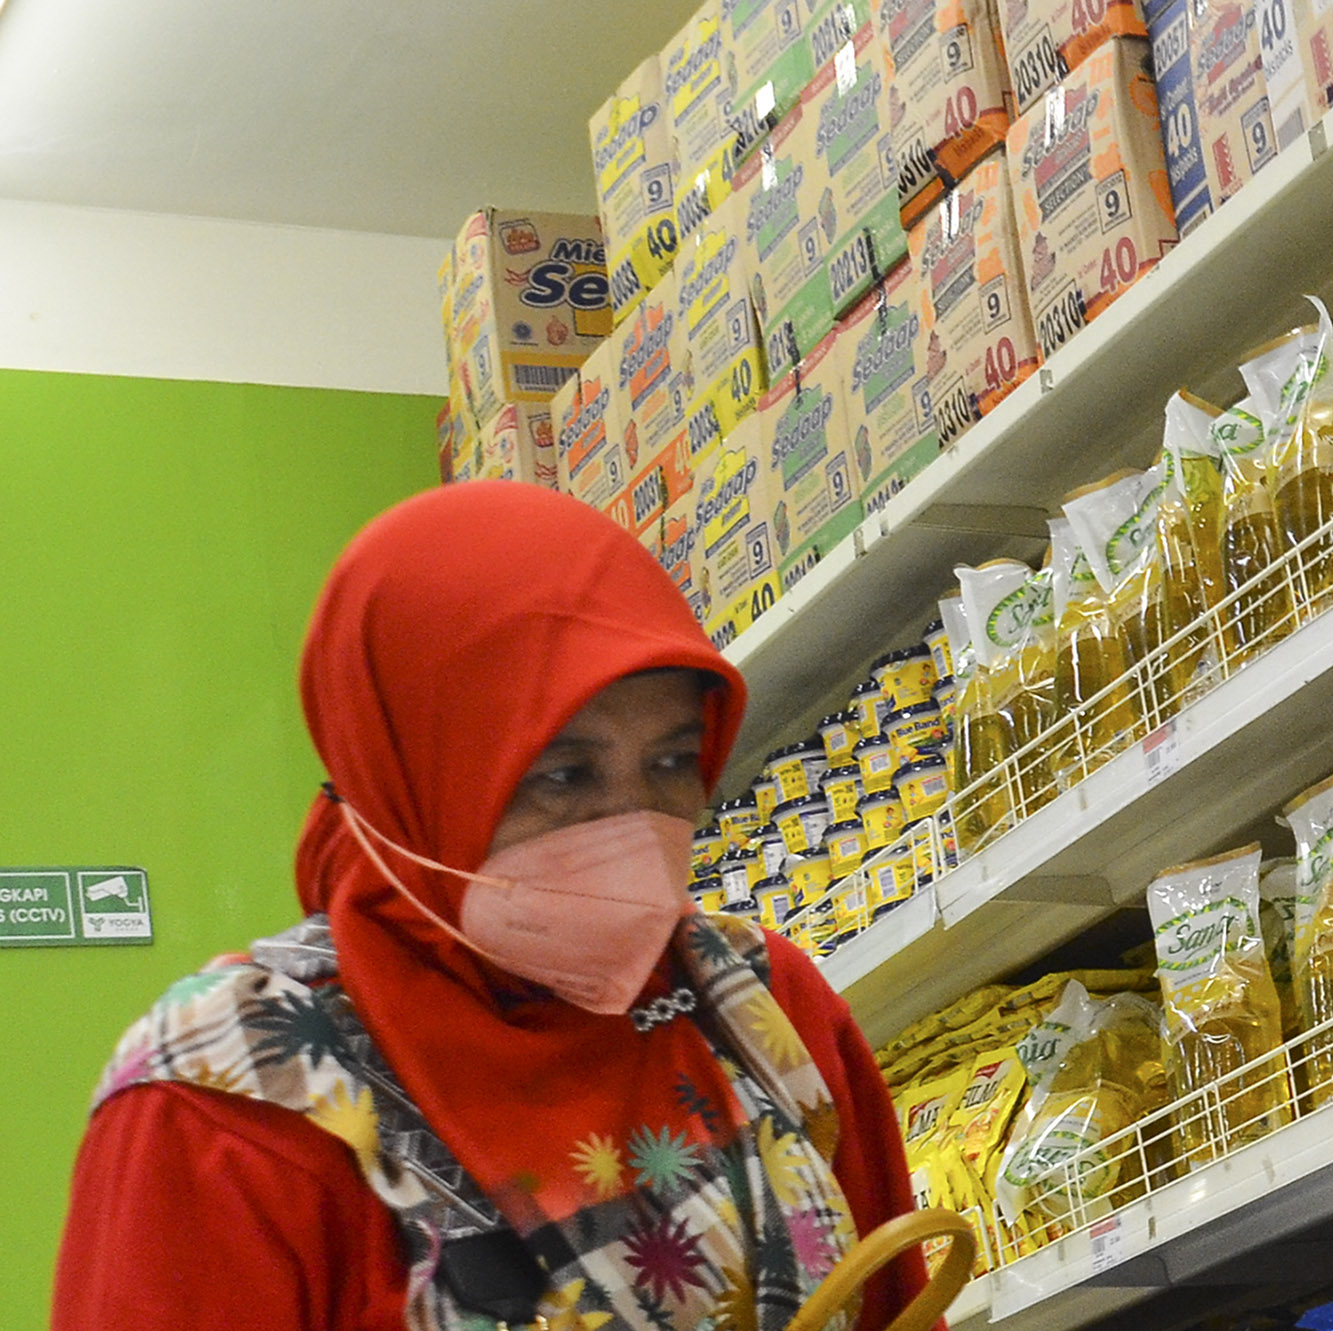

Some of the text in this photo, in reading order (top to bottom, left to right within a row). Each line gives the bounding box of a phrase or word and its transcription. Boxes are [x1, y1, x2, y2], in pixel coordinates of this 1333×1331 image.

[1262, 0, 1286, 51] 40
[947, 41, 962, 68] 9
[1014, 36, 1056, 106] 20310
[945, 87, 977, 137] 40
[1168, 103, 1191, 158] 40
[1252, 121, 1267, 154] 9
[646, 178, 664, 202] 9
[1105, 190, 1121, 218] 9
[648, 219, 677, 259] 40
[804, 234, 817, 263] 9
[1100, 237, 1137, 294] 40
[987, 293, 1002, 318] 9
[732, 318, 741, 342] 9
[1040, 291, 1081, 360] 20310
[852, 312, 920, 394] Sedaap
[985, 337, 1016, 389] 40
[732, 358, 751, 403] 40
[921, 391, 933, 419] 9
[772, 392, 833, 471] Sedaap
[694, 459, 757, 527] Sedaap
[832, 472, 843, 497] 9
[751, 539, 765, 567] 9
[914, 718, 941, 732] Band
[10, 908, 65, 923] (CCTV)
[109, 918, 144, 928] YOGYA
[1167, 914, 1237, 951] Sania
